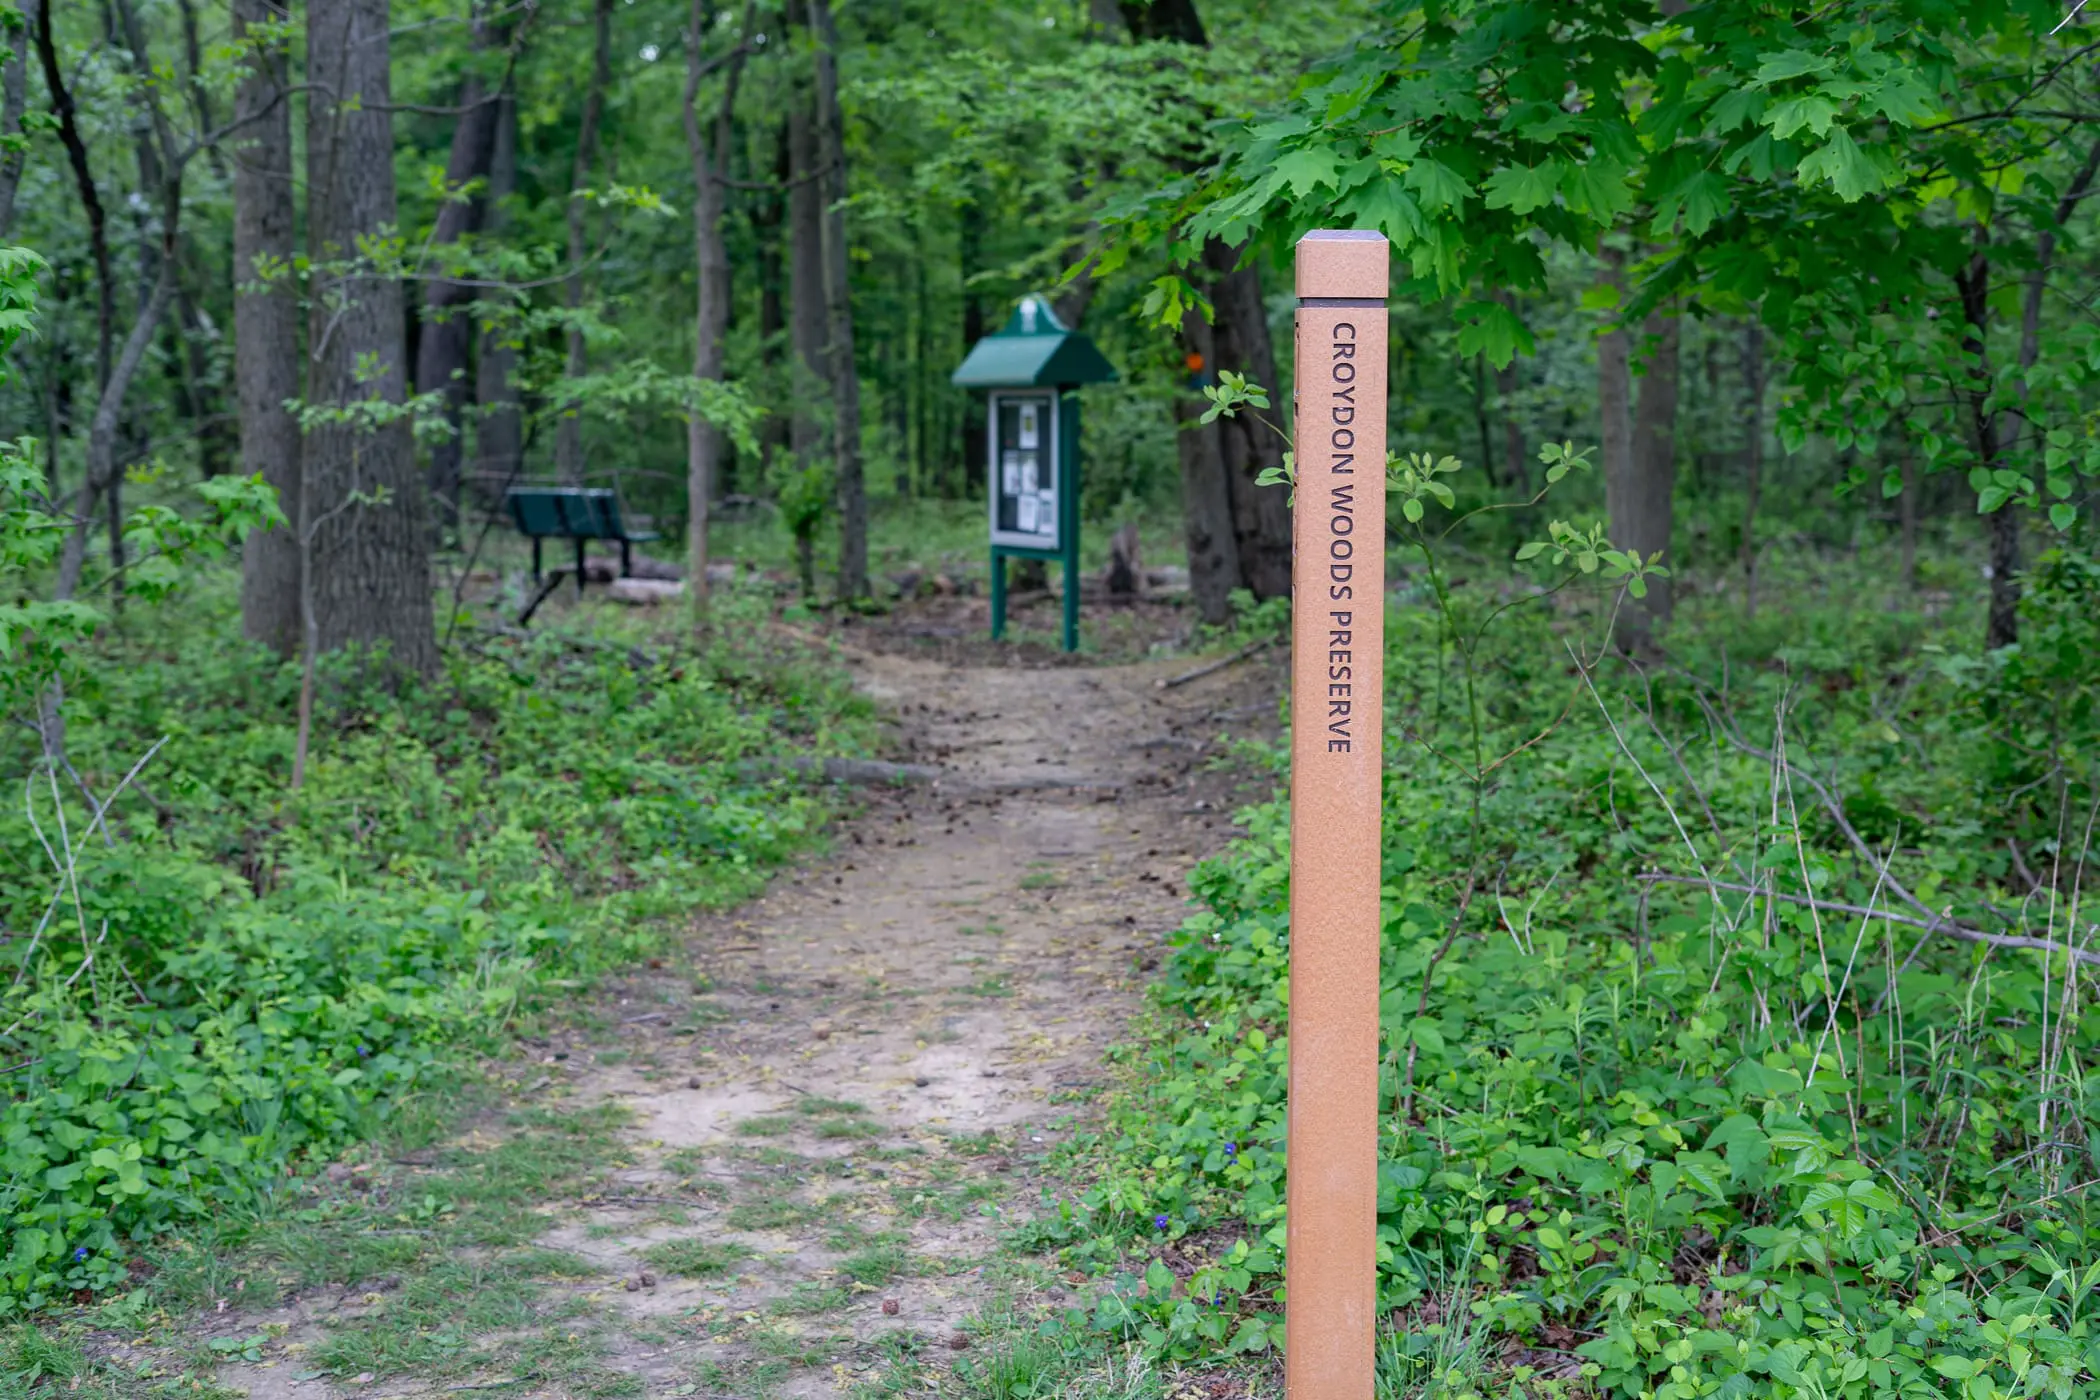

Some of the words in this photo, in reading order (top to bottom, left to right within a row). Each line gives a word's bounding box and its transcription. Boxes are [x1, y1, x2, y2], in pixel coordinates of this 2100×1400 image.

[1331, 322, 1356, 474] CROYDON
[1329, 484, 1354, 601] WOODS
[1328, 611, 1353, 753] PRESERVE
